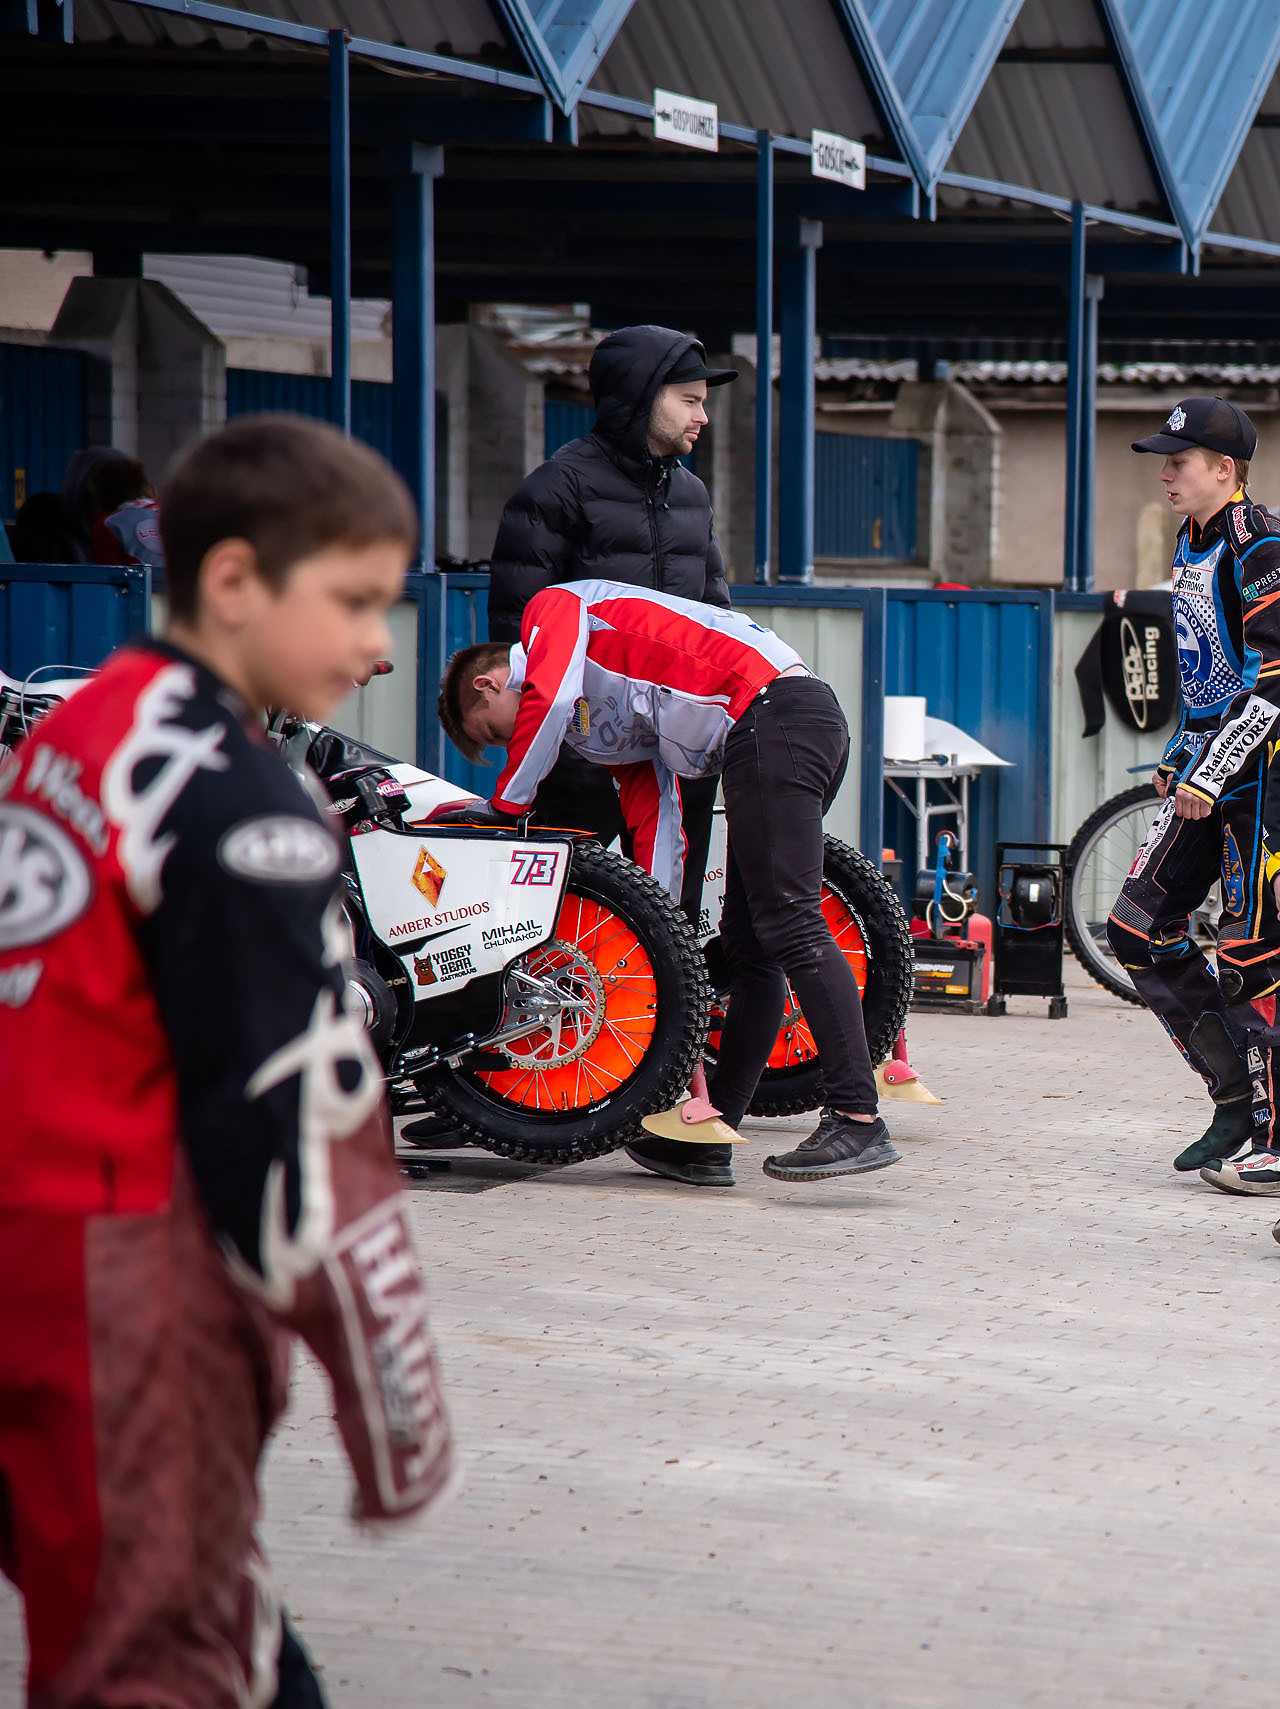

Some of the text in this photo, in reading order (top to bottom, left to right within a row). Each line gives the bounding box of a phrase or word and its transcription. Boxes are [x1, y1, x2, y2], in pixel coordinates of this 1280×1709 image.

[1143, 626, 1160, 700] Racing
[1198, 704, 1261, 782] Maintenance
[1211, 711, 1274, 789] NETWORK
[1141, 832, 1164, 862] Training
[511, 850, 559, 886] 73
[388, 901, 490, 938] AMBER STUDIOS
[481, 919, 543, 942] MIHAIL
[431, 943, 472, 965] YOGGY
[483, 929, 543, 950] CHUMAKOV
[440, 957, 472, 976] BEAR
